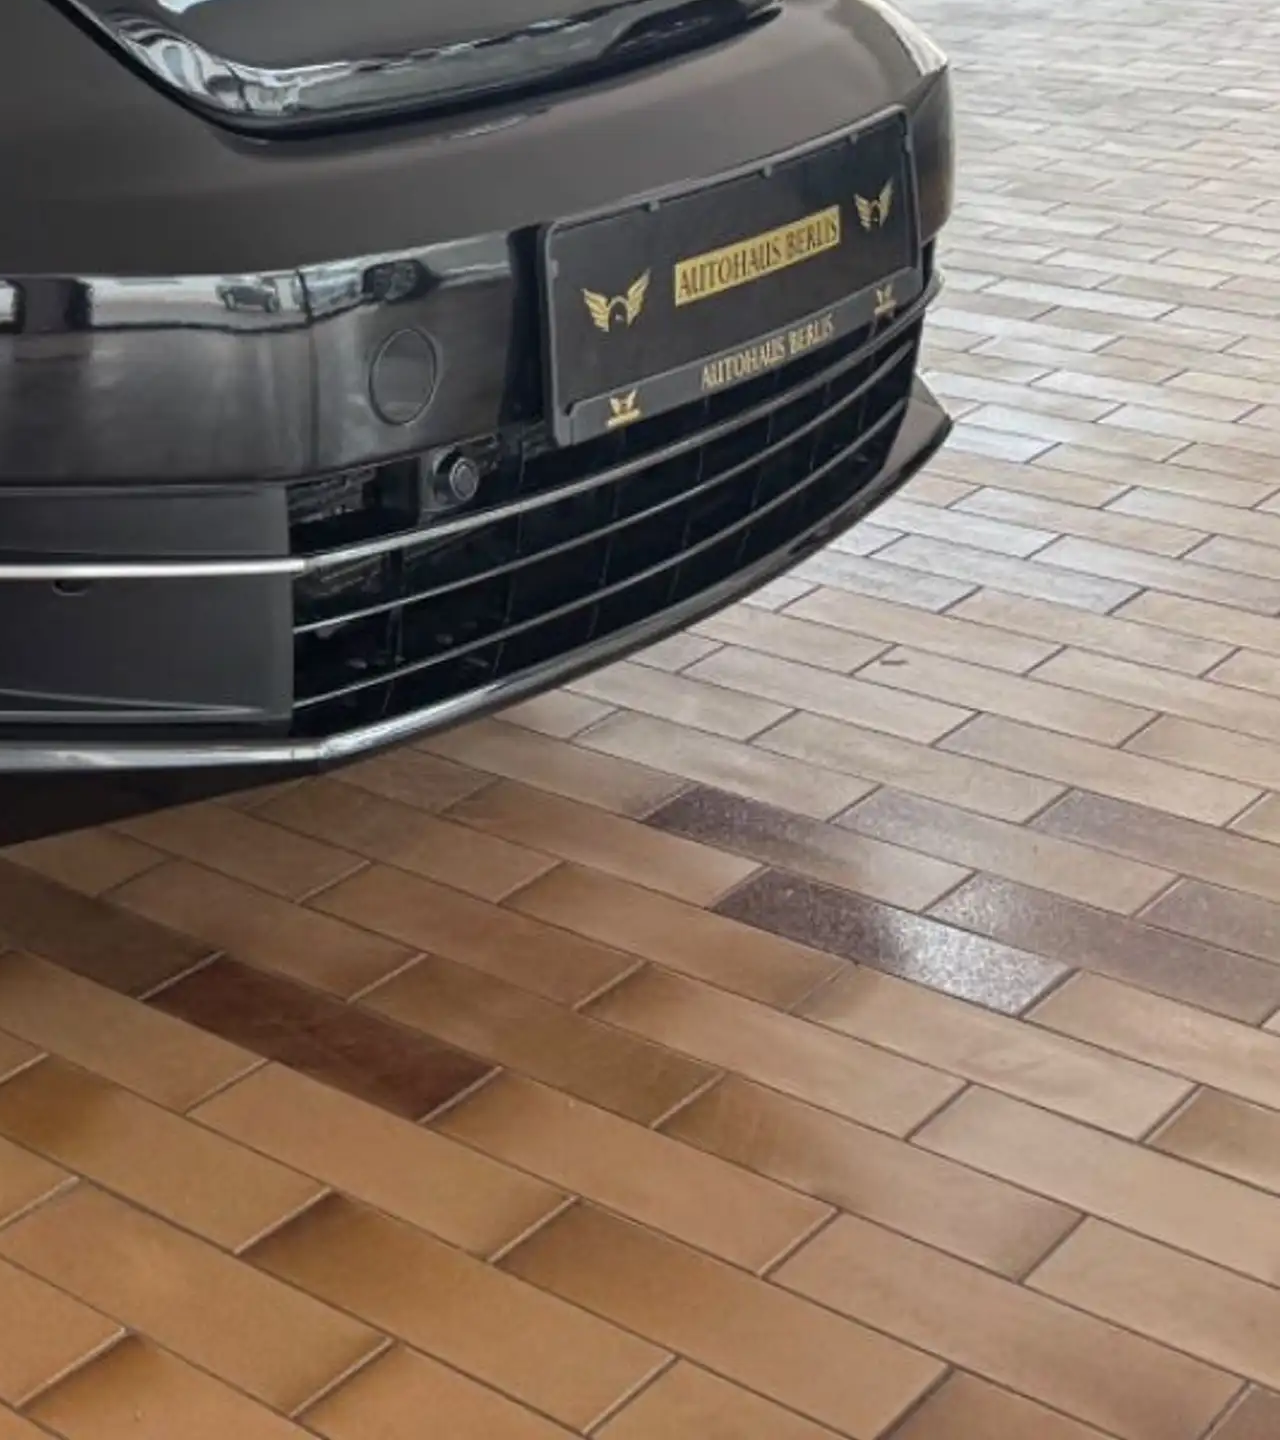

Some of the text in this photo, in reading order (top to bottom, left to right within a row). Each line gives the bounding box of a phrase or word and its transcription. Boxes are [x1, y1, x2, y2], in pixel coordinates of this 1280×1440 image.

[678, 215, 838, 299] AUTOHAUS BERLIS
[701, 313, 834, 390] AUTOHAUS BERLIS
